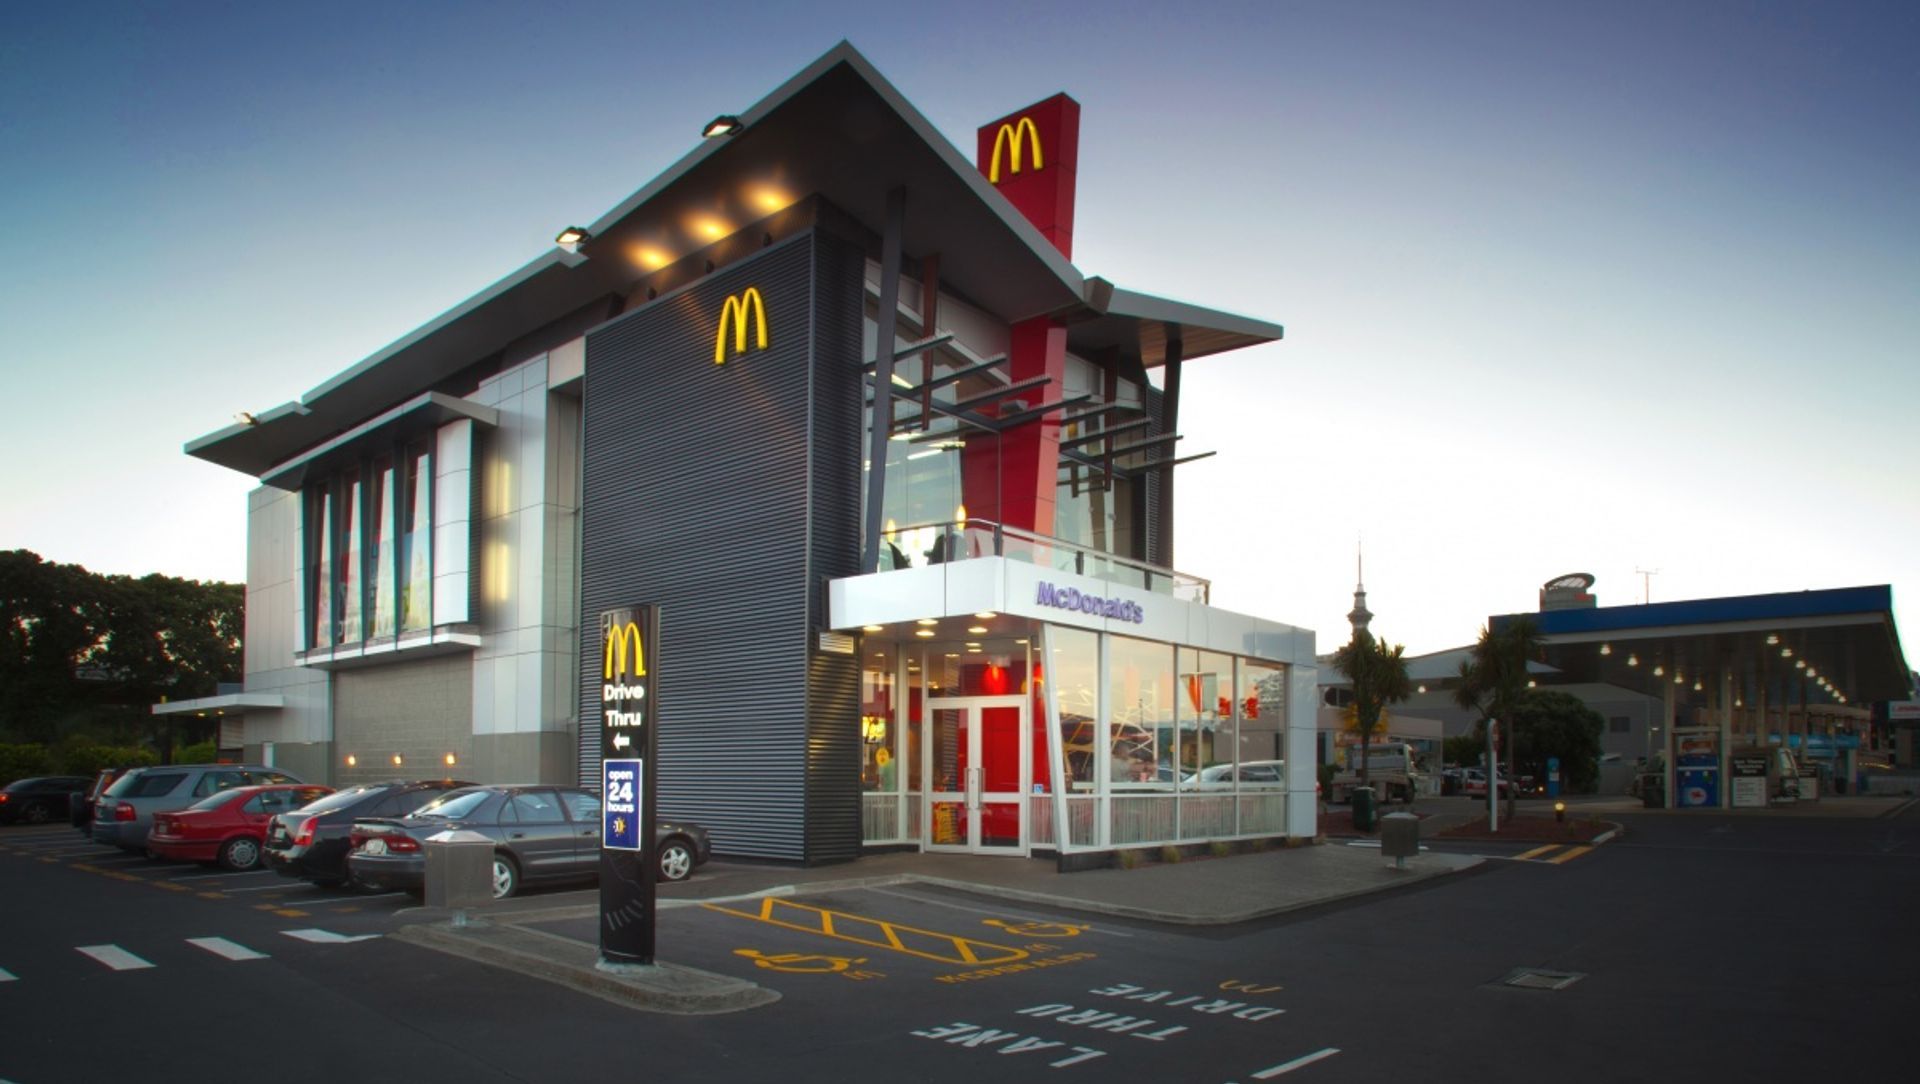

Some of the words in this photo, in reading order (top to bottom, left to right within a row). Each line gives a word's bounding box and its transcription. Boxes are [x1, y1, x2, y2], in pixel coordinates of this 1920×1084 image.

[989, 117, 1043, 184] M
[714, 287, 769, 366] M
[1036, 581, 1144, 624] McDonald's
[605, 622, 646, 679] M
[603, 684, 645, 701] Drive
[605, 710, 641, 727] Thru
[608, 770, 634, 782] open
[608, 782, 633, 801] 24
[607, 801, 634, 814] hours
[1089, 983, 1287, 1021] DRIVE
[1014, 1003, 1188, 1041] THRU
[910, 1022, 1107, 1068] LANE
